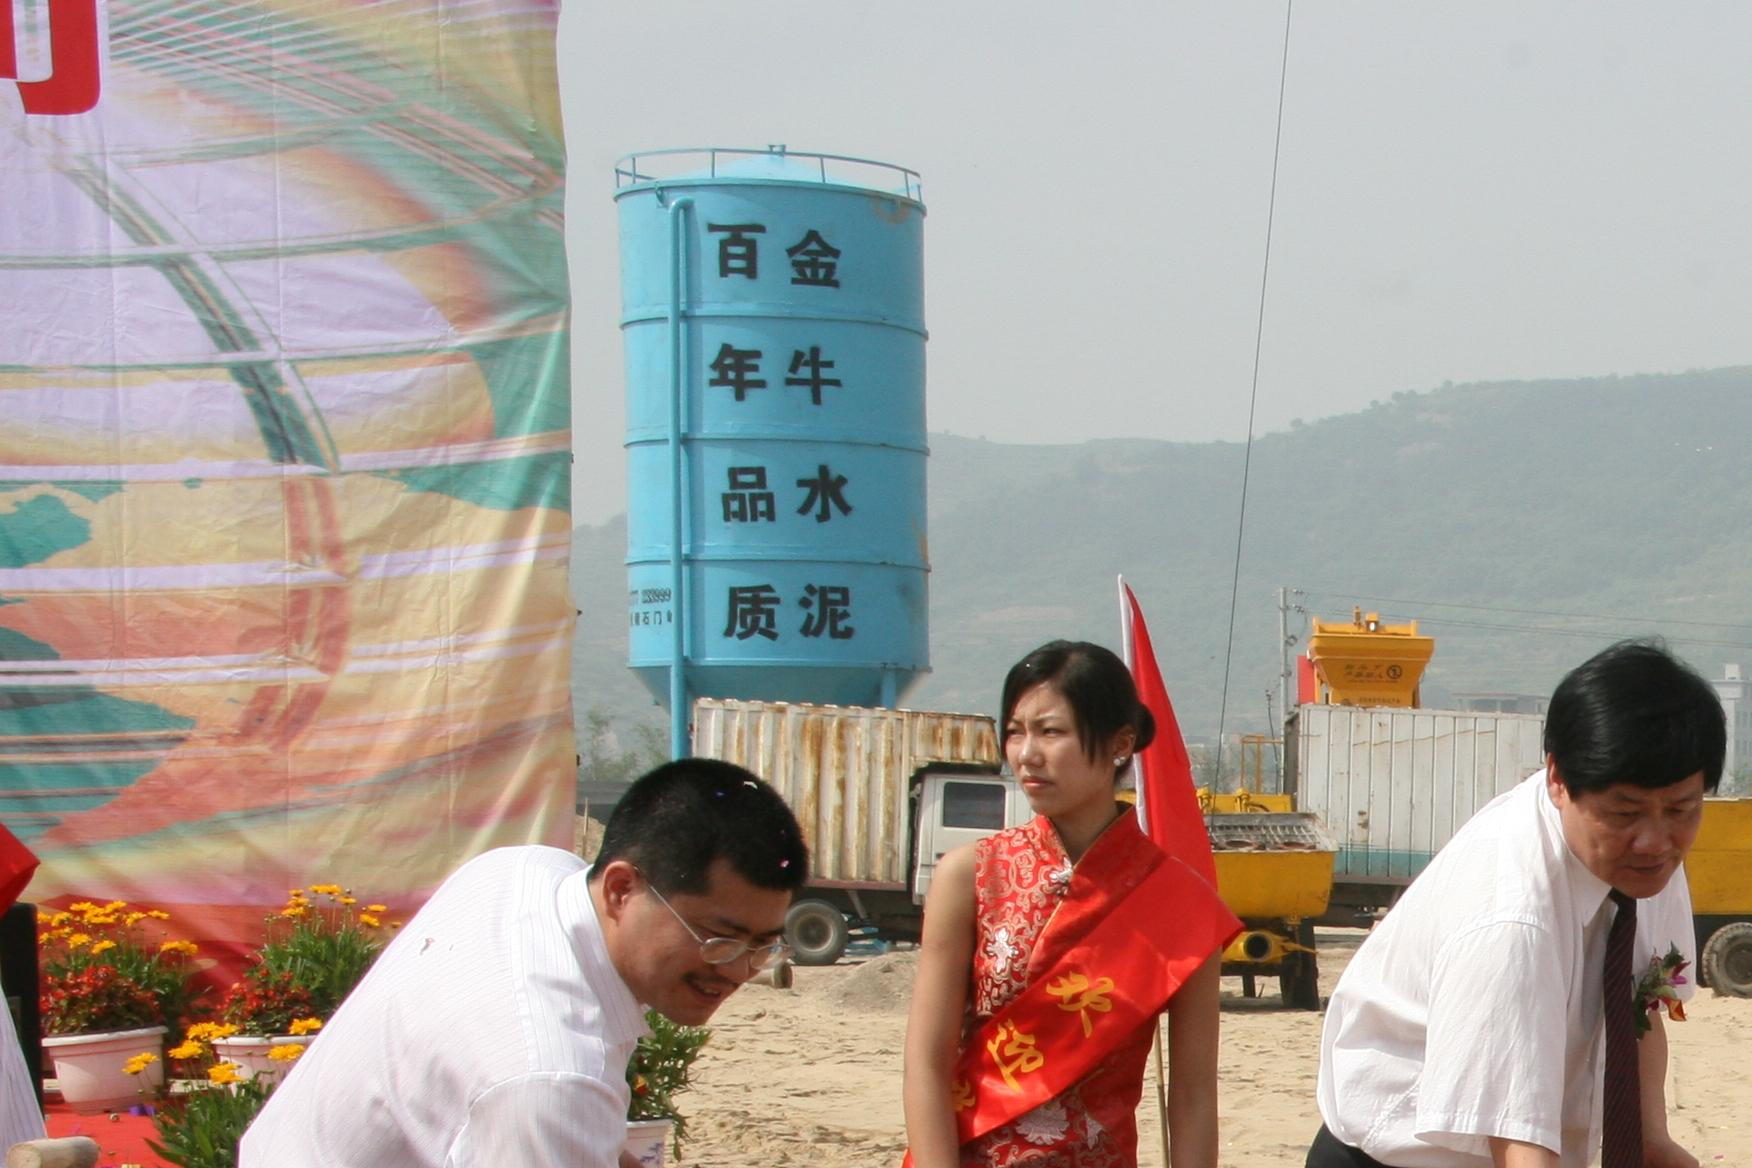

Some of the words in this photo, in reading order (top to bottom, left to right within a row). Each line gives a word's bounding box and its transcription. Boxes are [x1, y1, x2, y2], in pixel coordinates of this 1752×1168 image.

[707, 223, 780, 640] 百年品质
[785, 230, 854, 640] 金牛水泥
